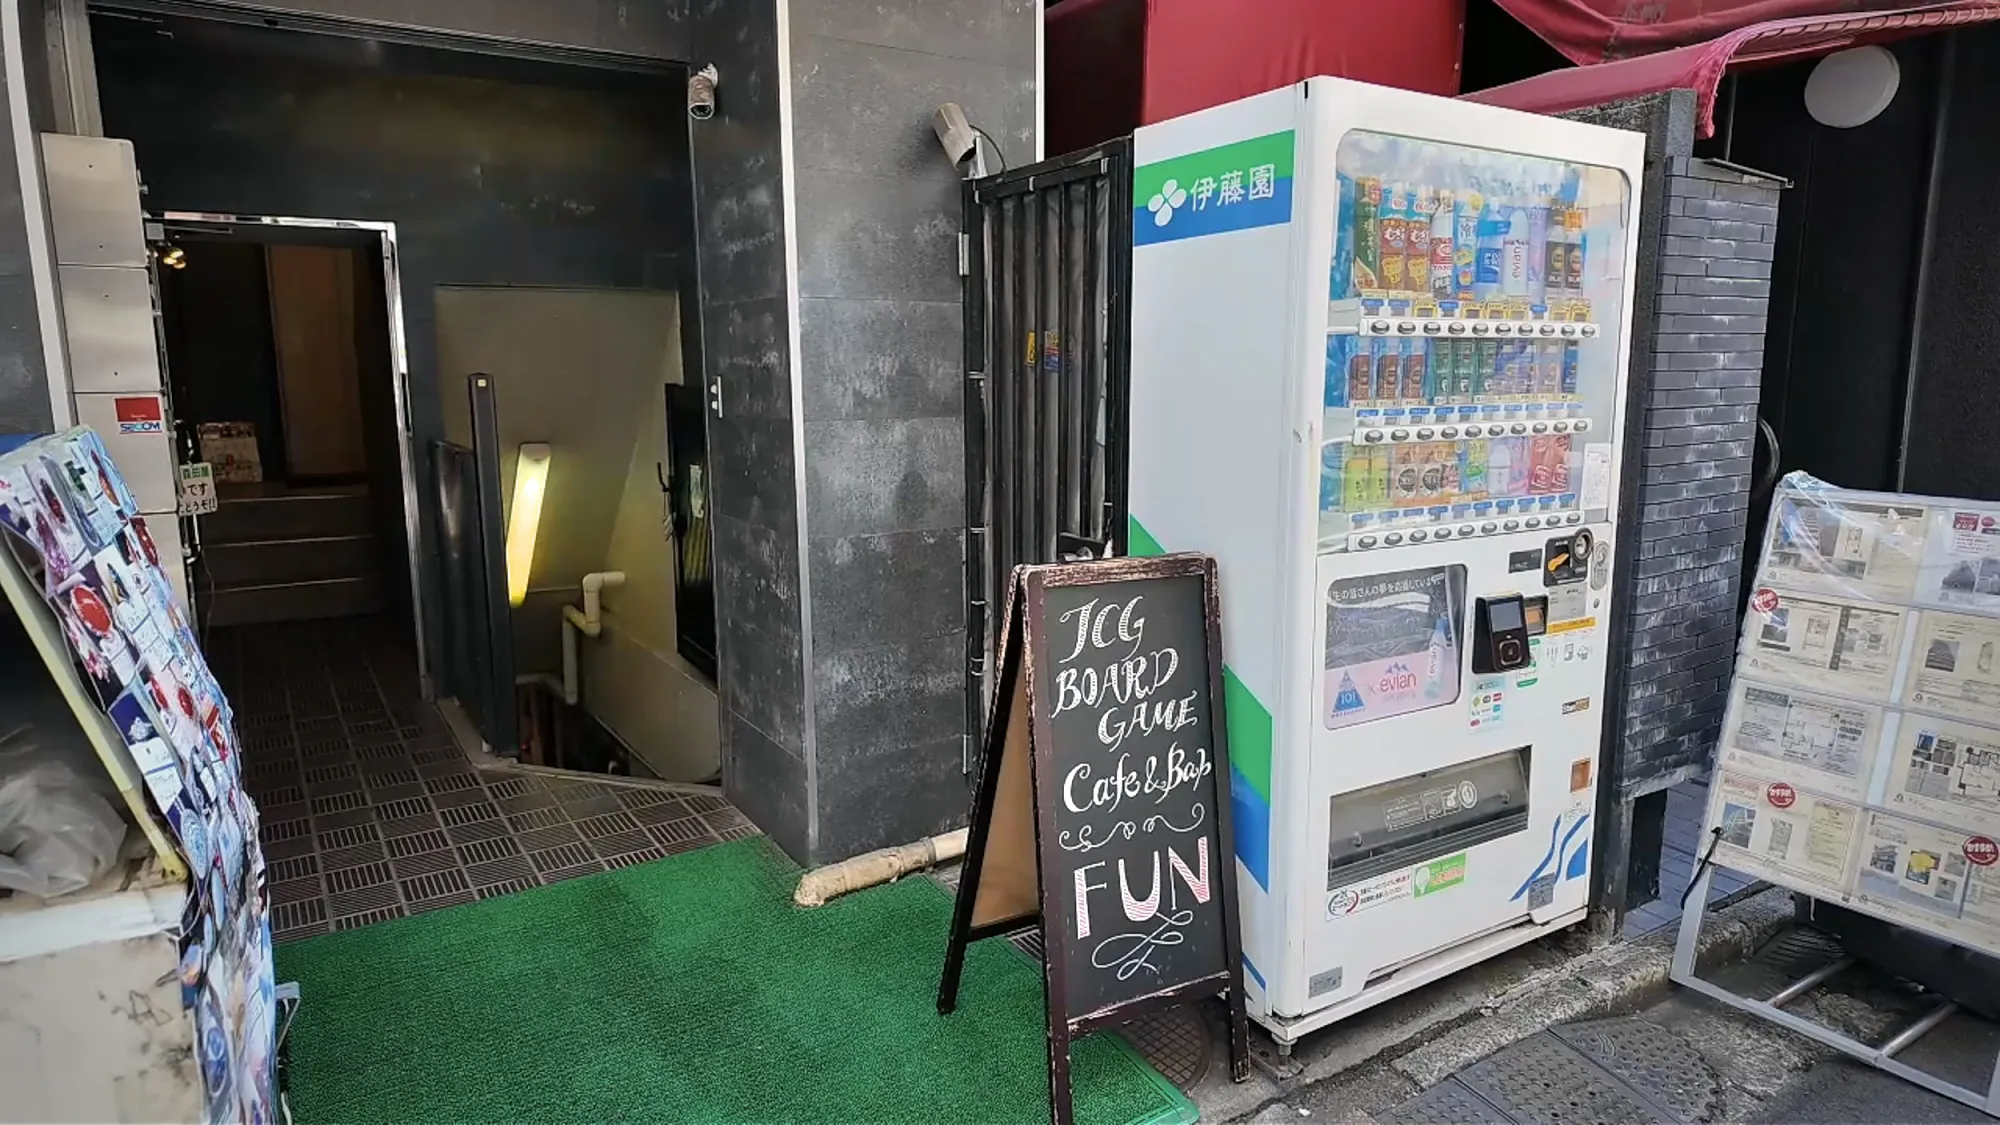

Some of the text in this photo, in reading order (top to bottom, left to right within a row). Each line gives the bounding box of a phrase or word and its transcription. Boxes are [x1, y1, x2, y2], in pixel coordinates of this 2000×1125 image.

[1190, 163, 1275, 211] 伊藤園
[1511, 246, 1521, 279] evian
[120, 422, 161, 432] SECOM
[1051, 648, 1178, 718] BOARD
[1380, 673, 1417, 692] evian
[1098, 690, 1197, 752] GAME
[1074, 836, 1210, 939] FUN
